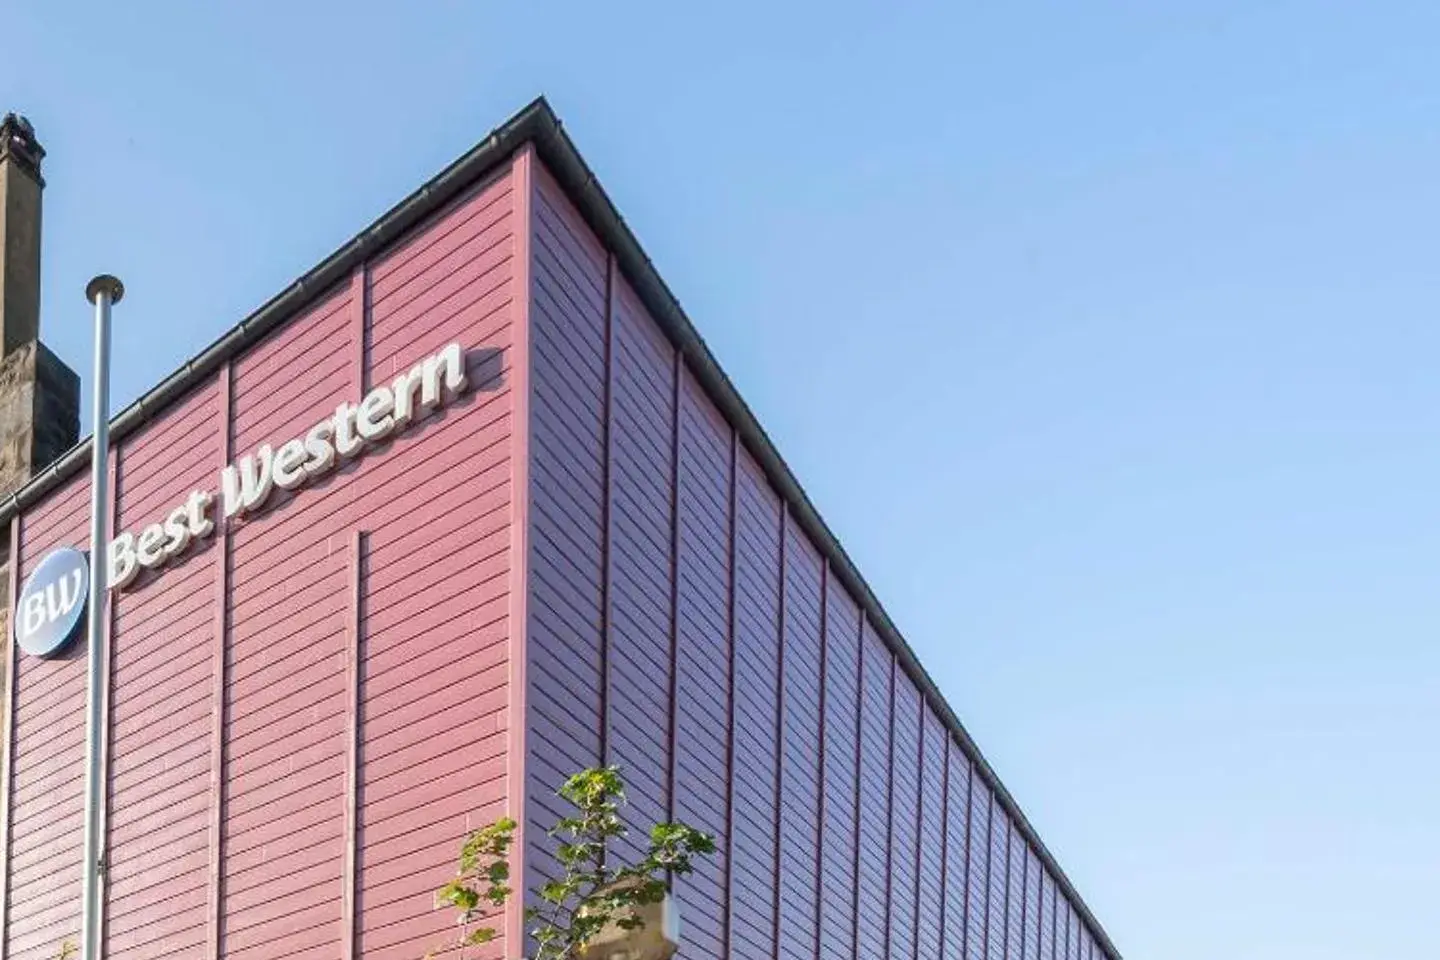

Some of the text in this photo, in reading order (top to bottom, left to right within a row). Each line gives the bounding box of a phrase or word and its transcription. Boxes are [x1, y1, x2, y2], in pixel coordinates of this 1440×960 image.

[107, 341, 466, 590] Best Western
[22, 567, 82, 638] BW
